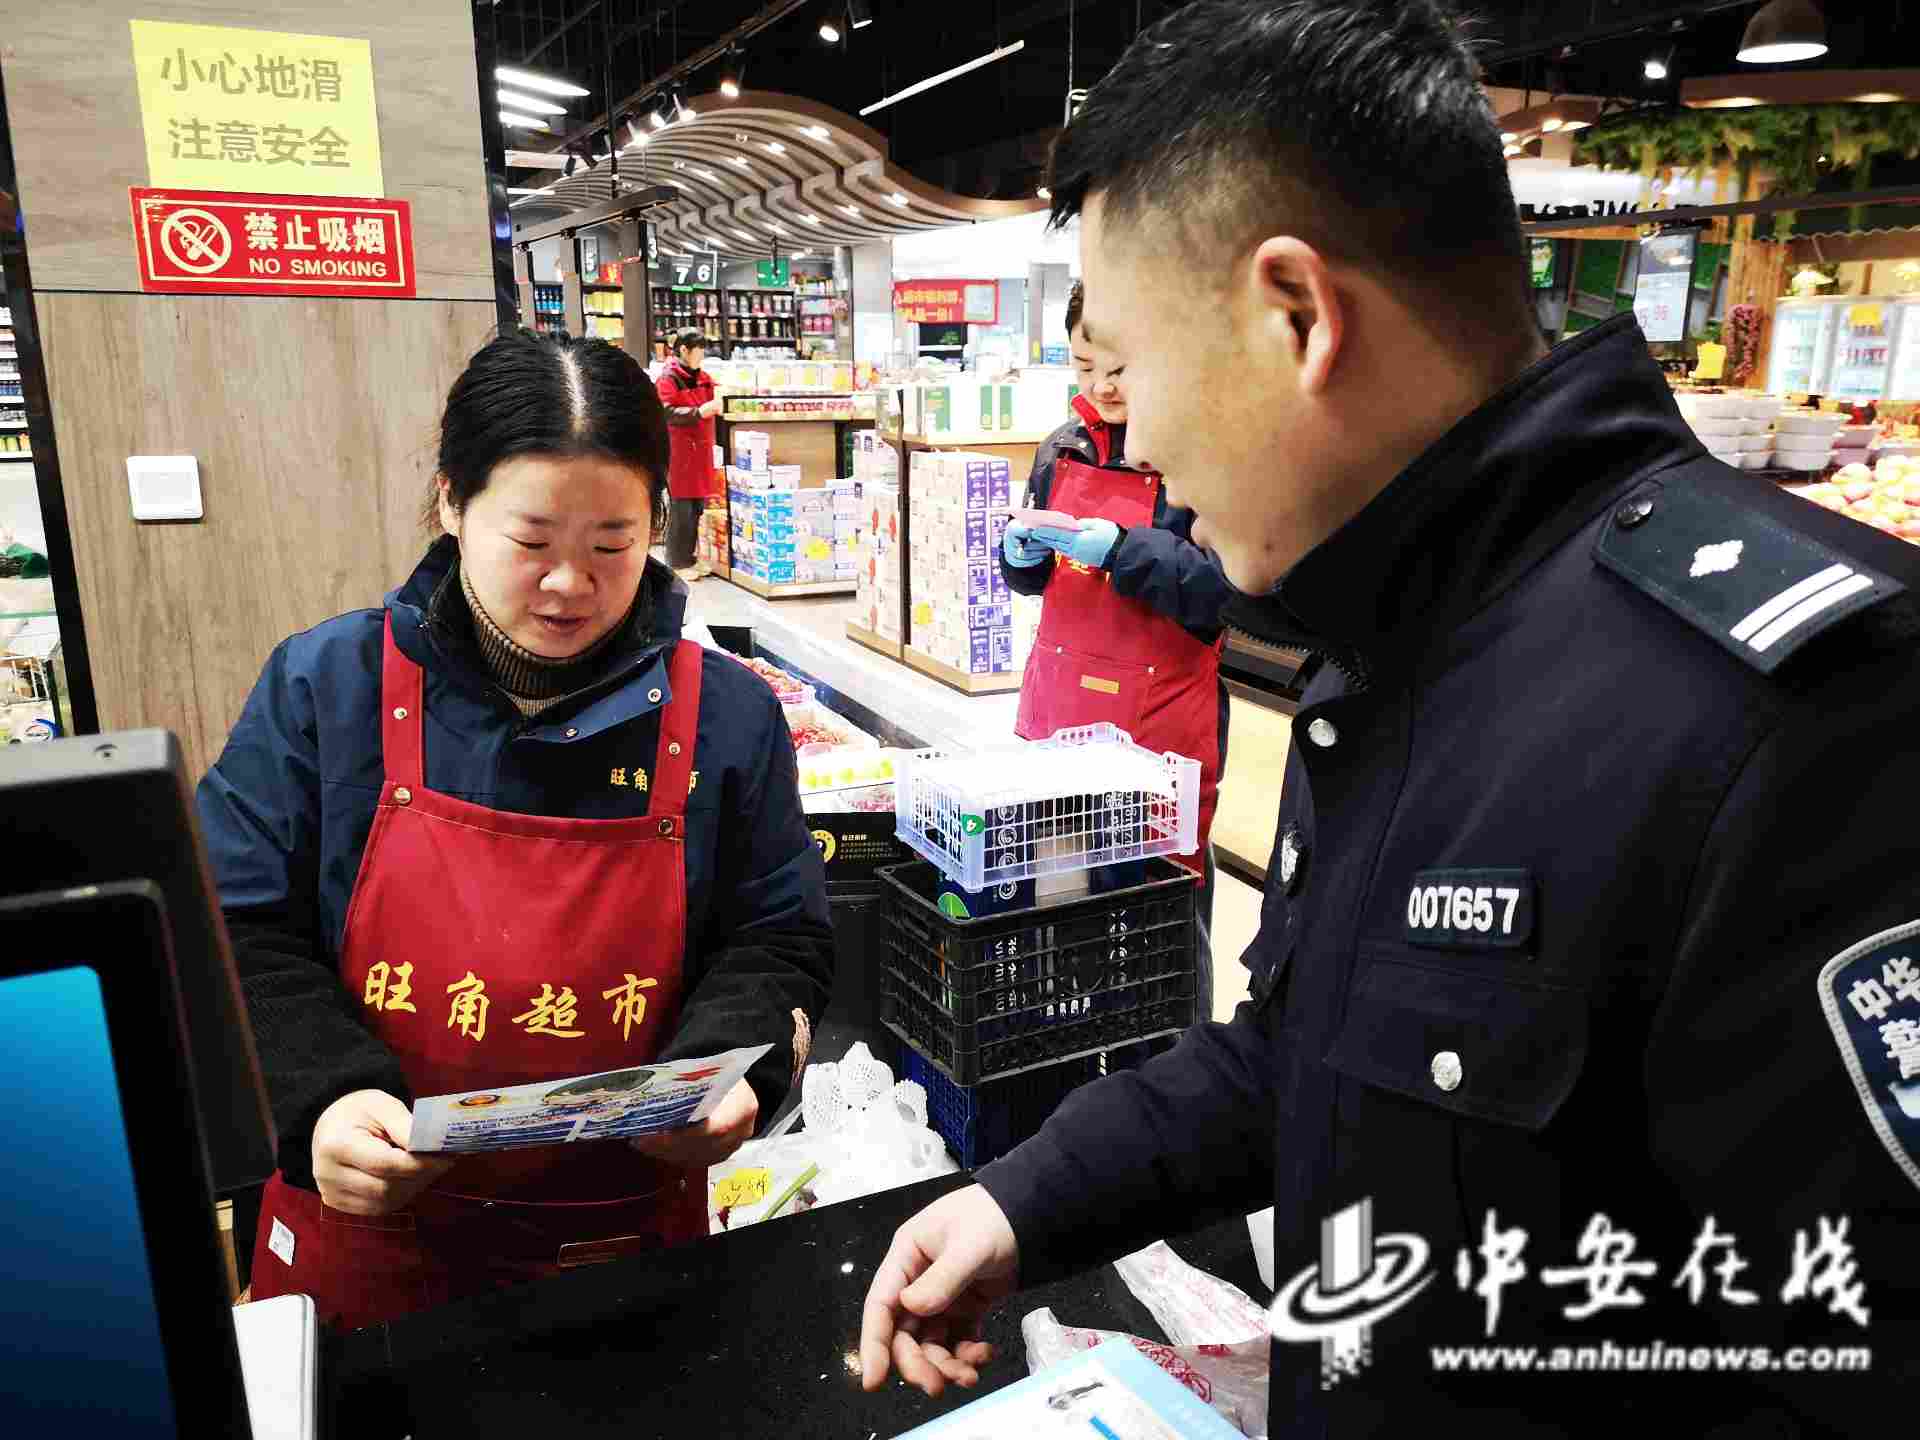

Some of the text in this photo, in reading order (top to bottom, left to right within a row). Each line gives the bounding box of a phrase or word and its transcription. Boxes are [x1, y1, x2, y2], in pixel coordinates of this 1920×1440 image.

[160, 48, 342, 102] 小心地滑
[168, 118, 351, 169] 注意安全
[244, 212, 386, 255] 禁止吸烟
[249, 258, 387, 278] NO SMOKING
[675, 267, 689, 284] 7
[697, 264, 711, 282] 6
[610, 767, 700, 794] 旺角市
[1408, 886, 1519, 934] 007657
[363, 960, 658, 1042] 旺角超市
